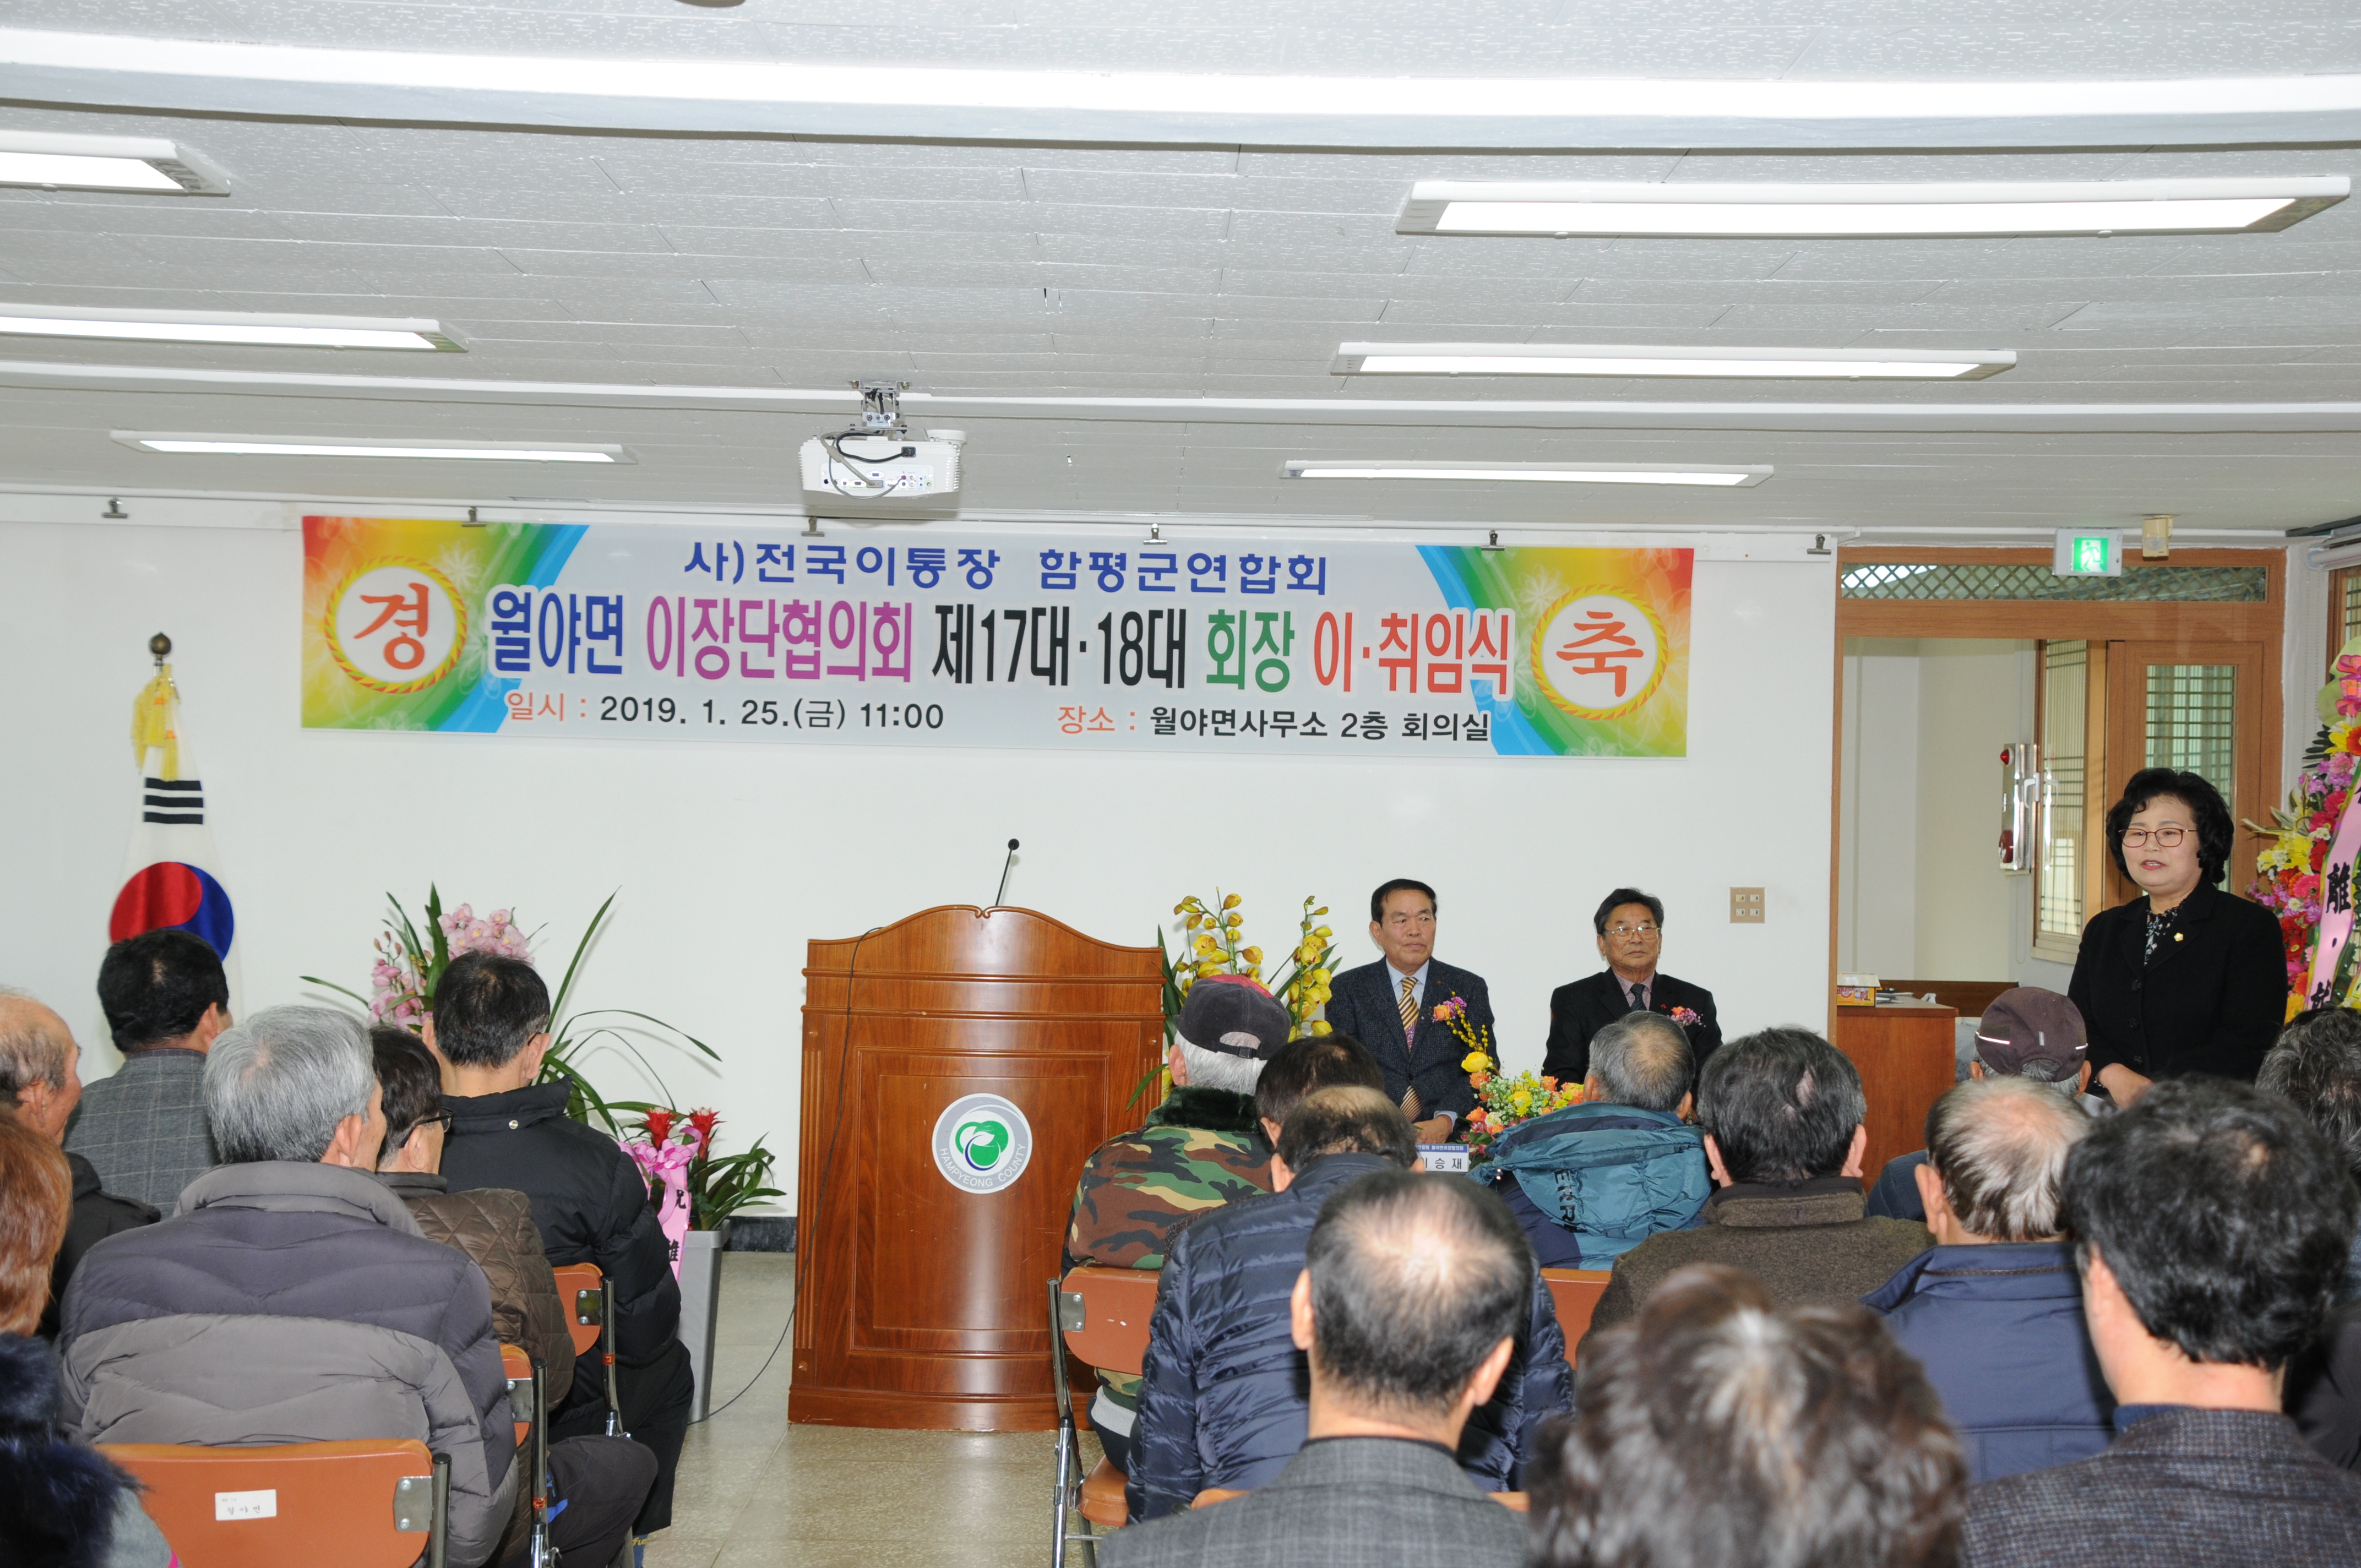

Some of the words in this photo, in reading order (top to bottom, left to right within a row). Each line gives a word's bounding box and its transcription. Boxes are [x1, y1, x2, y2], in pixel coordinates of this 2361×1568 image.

[1040, 549, 1326, 595] 함평군연합회
[353, 582, 430, 671] 경
[492, 591, 623, 674] 월야면
[648, 596, 912, 682] 이장단협의회
[1207, 610, 1294, 692] 회장
[1556, 611, 1645, 698] 축
[861, 703, 943, 729] 11:00
[1150, 707, 1328, 738] 월야면사무소
[1341, 711, 1388, 740] 2층
[1402, 713, 1488, 741] 회의실
[939, 1148, 993, 1188] HAMPYEONG
[998, 1143, 1026, 1183] COUNTY
